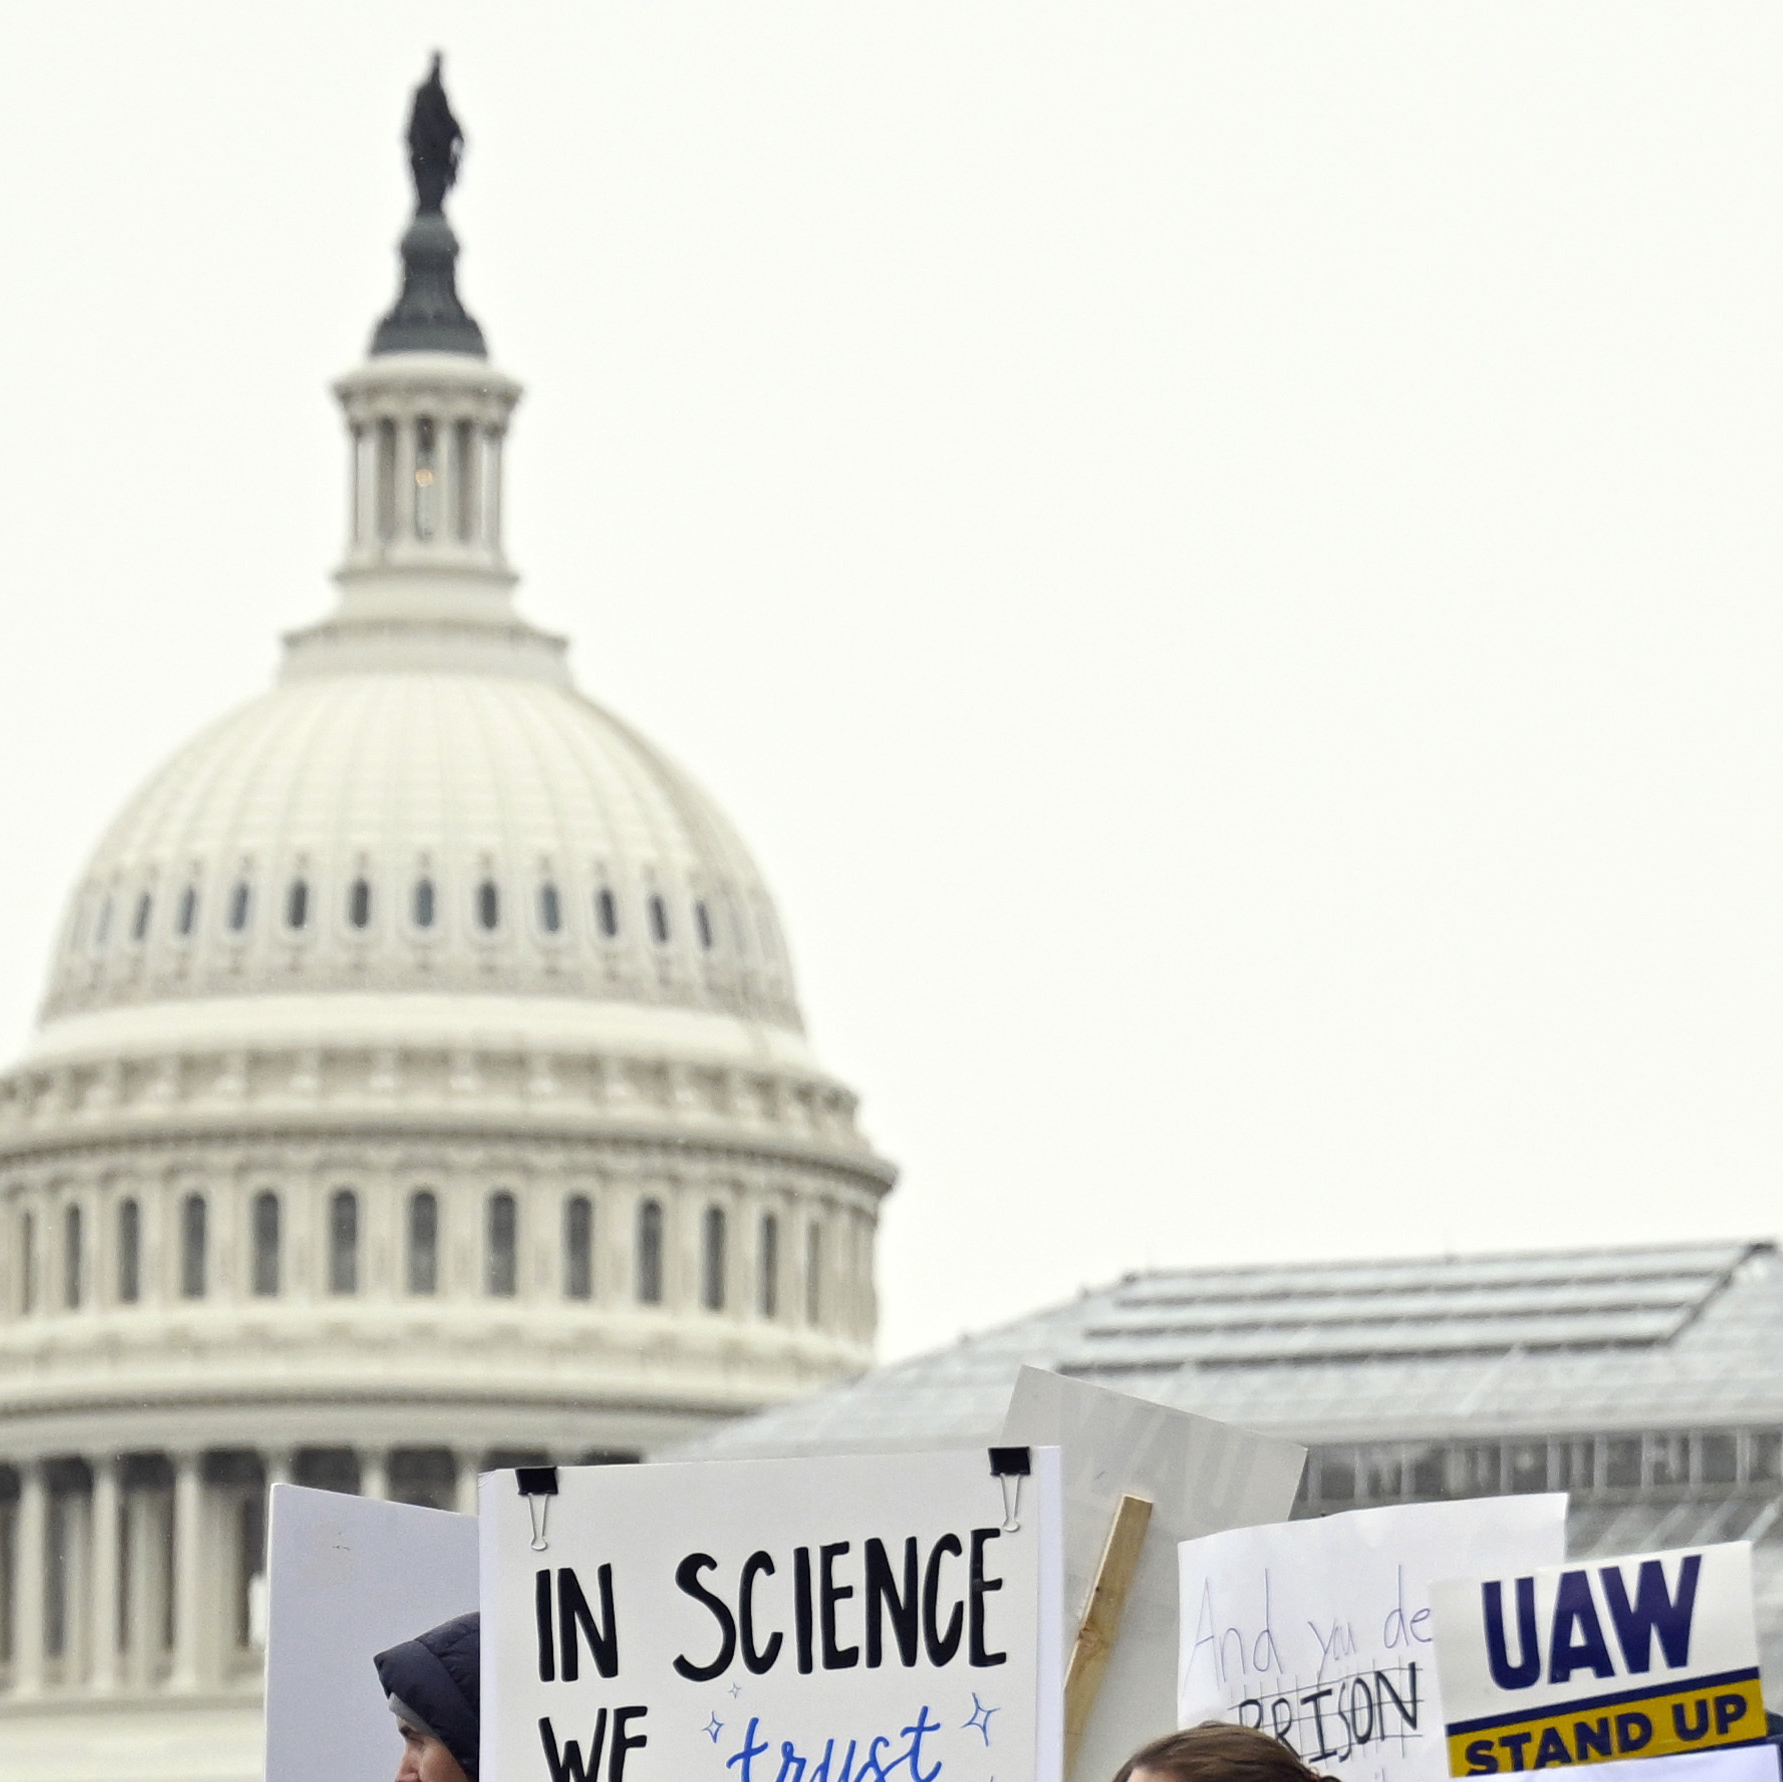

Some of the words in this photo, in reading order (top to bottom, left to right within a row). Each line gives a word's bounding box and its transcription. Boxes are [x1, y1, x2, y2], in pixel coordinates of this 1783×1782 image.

[534, 1561, 620, 1682] IN
[672, 1526, 1008, 1682] SCIENCE
[1182, 1568, 1283, 1692] And
[1480, 1553, 1703, 1693] UAW
[1465, 1712, 1654, 1776] STAND
[1674, 1693, 1748, 1738] UP
